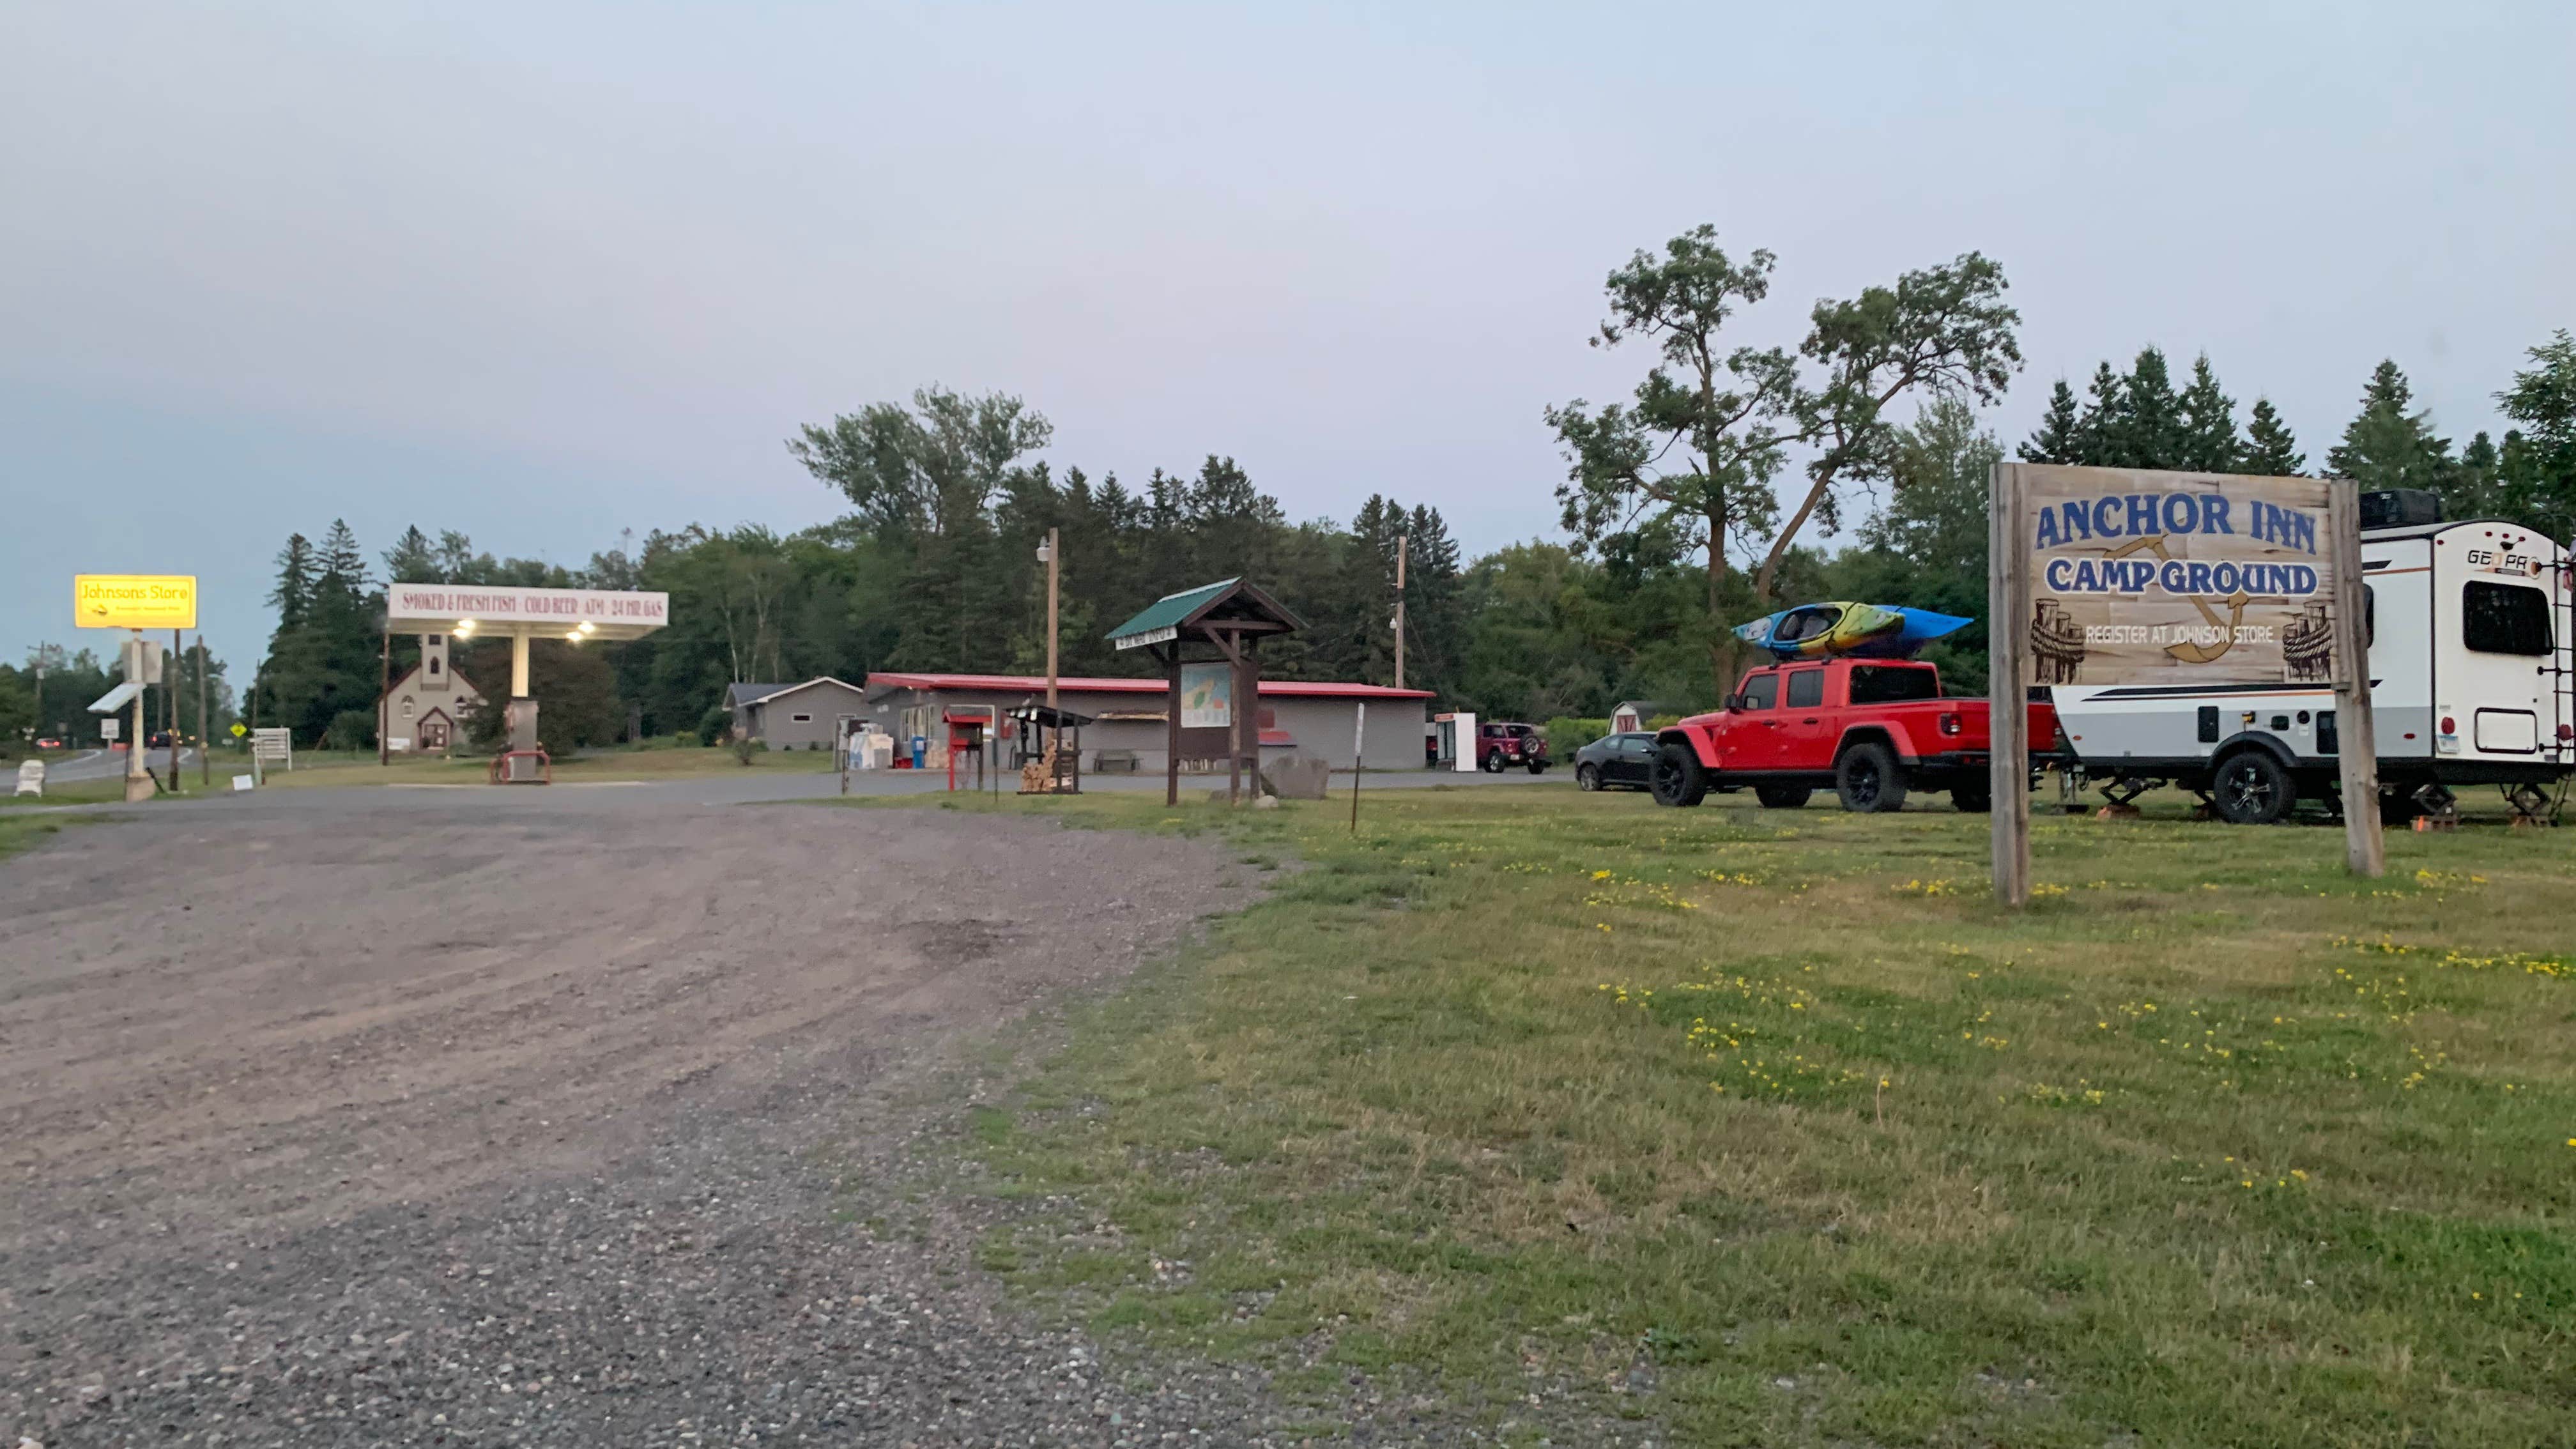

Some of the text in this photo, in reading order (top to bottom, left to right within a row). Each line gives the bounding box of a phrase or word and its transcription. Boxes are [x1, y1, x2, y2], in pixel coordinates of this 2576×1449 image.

[2036, 493, 2317, 555] ANCHOR INN
[83, 583, 187, 599] Johnsons Store
[403, 592, 445, 611] SMOKED
[457, 594, 490, 611] FRESH
[493, 595, 516, 612] FISH
[525, 596, 550, 613] COLD
[553, 597, 578, 614] BEER
[611, 599, 624, 616] 24
[643, 601, 663, 617] GAS
[2086, 625, 2273, 643] REGISTER AT JOHNSON STORE
